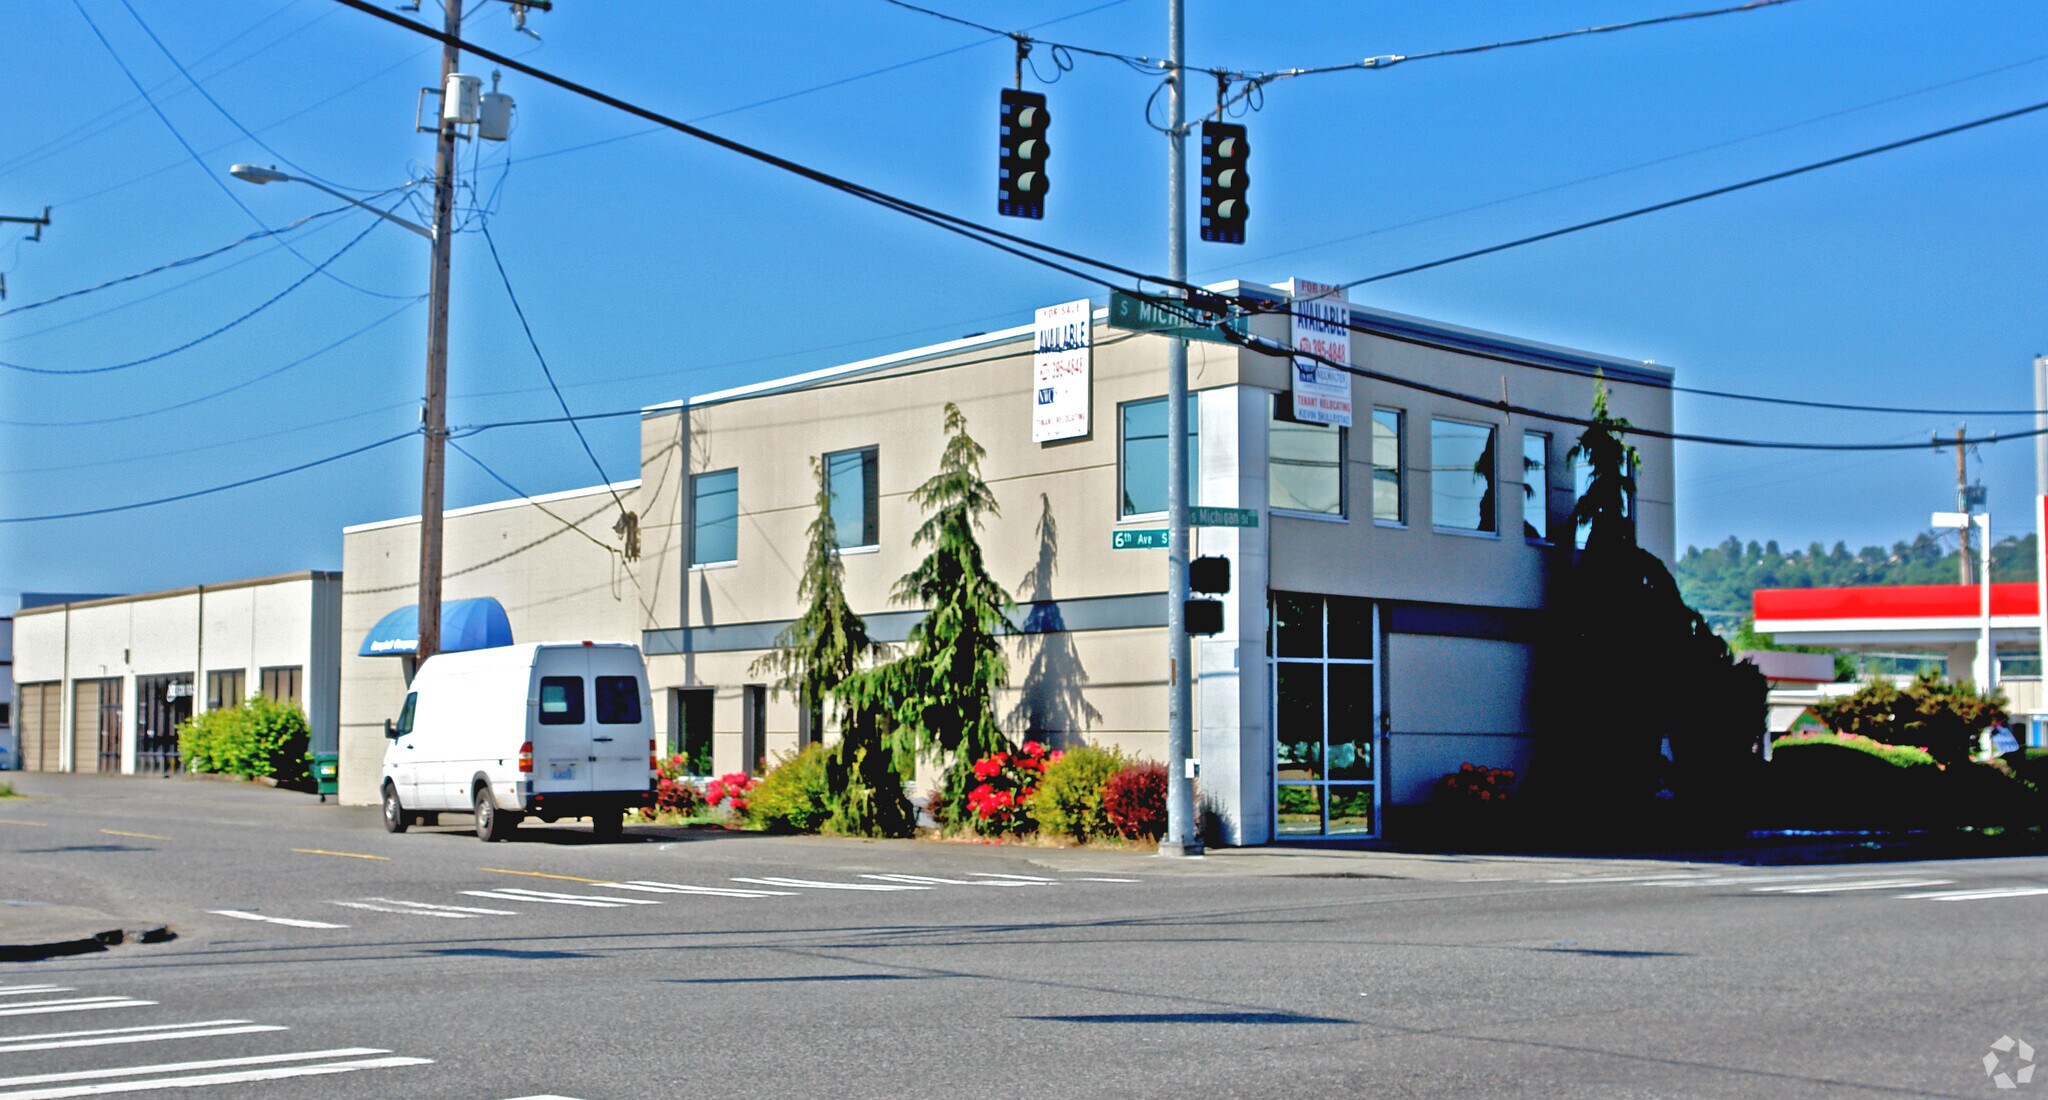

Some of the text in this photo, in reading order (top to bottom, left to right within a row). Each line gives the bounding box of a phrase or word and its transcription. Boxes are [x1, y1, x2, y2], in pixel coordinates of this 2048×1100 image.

[1300, 280, 1319, 294] FOR
[1121, 301, 1128, 316] S
[1298, 301, 1347, 337] AVAILABLE
[1040, 321, 1086, 353] AVAILABLE
[1297, 395, 1351, 413] TENANT RELOCATING
[1199, 509, 1239, 527] Michigan
[1115, 532, 1168, 548] 6th Ave S
